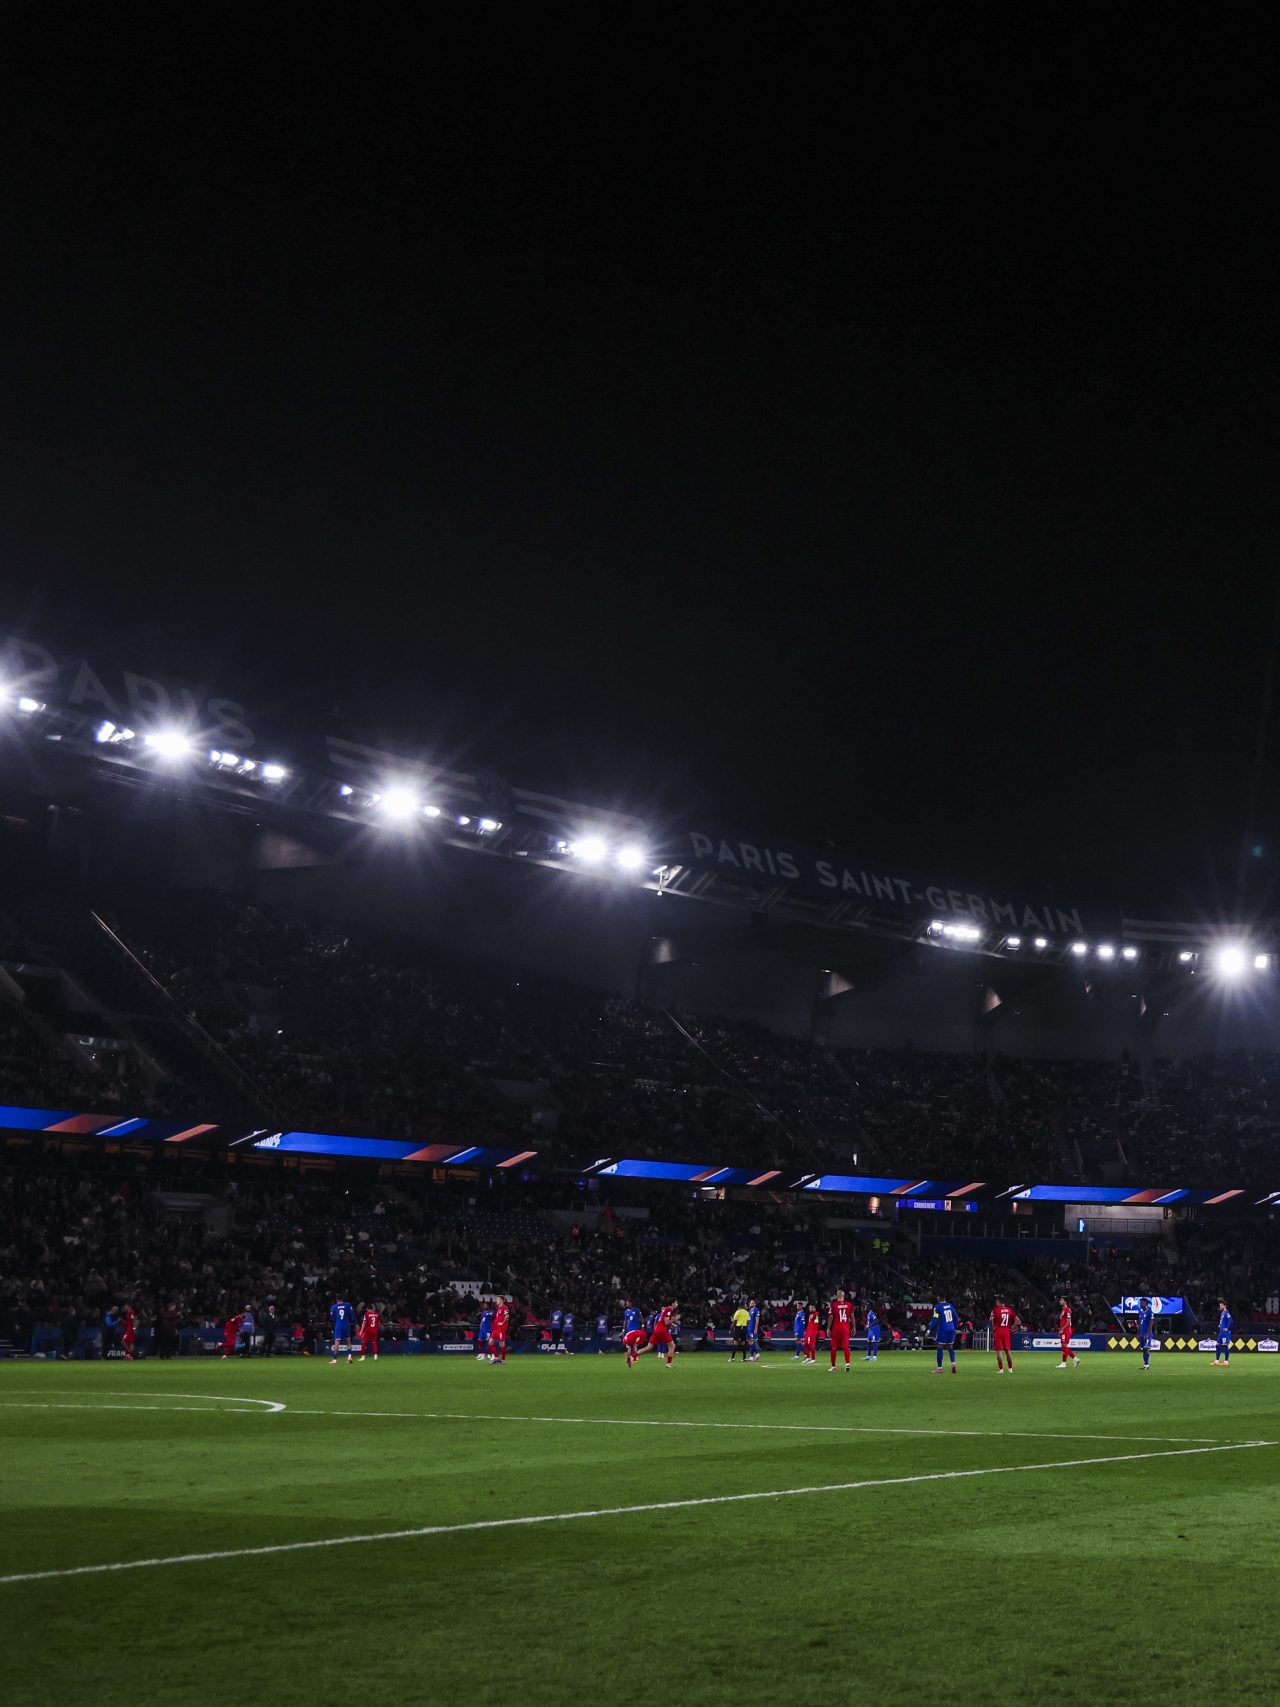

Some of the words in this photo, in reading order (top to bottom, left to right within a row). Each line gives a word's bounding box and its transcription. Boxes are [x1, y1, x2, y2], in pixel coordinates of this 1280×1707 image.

[690, 832, 799, 880] PARIS
[816, 861, 1085, 934] SAINT-GERMAIN
[338, 1309, 345, 1320] 9
[839, 1309, 848, 1323] 14
[943, 1309, 953, 1323] 10
[1001, 1313, 1009, 1327] 21
[371, 1317, 376, 1327] 3
[1259, 1343, 1277, 1351] Pasquier
